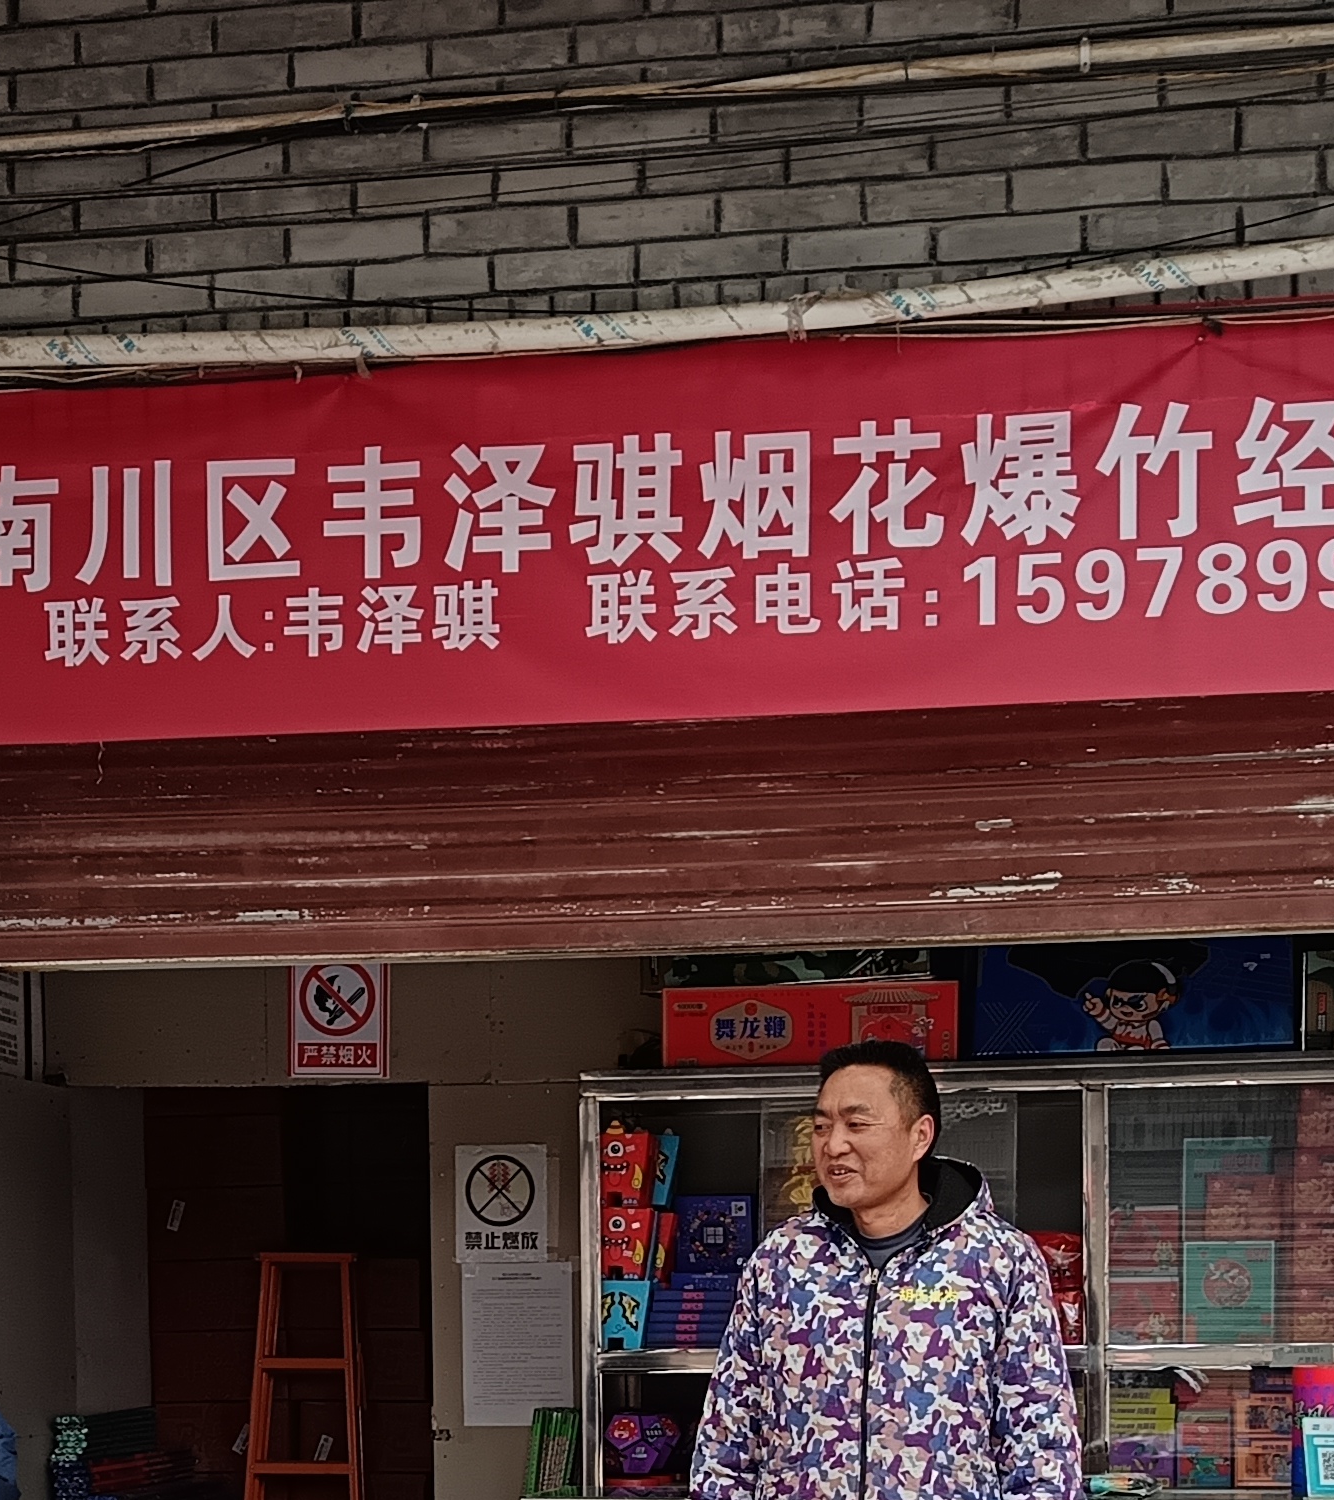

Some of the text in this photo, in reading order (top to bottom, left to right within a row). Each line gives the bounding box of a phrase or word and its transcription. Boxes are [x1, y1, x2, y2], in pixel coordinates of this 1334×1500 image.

[715, 1016, 786, 1040] 舞龙鞭
[303, 1045, 372, 1066] 严禁烟火
[465, 1231, 539, 1251] 禁止燃放
